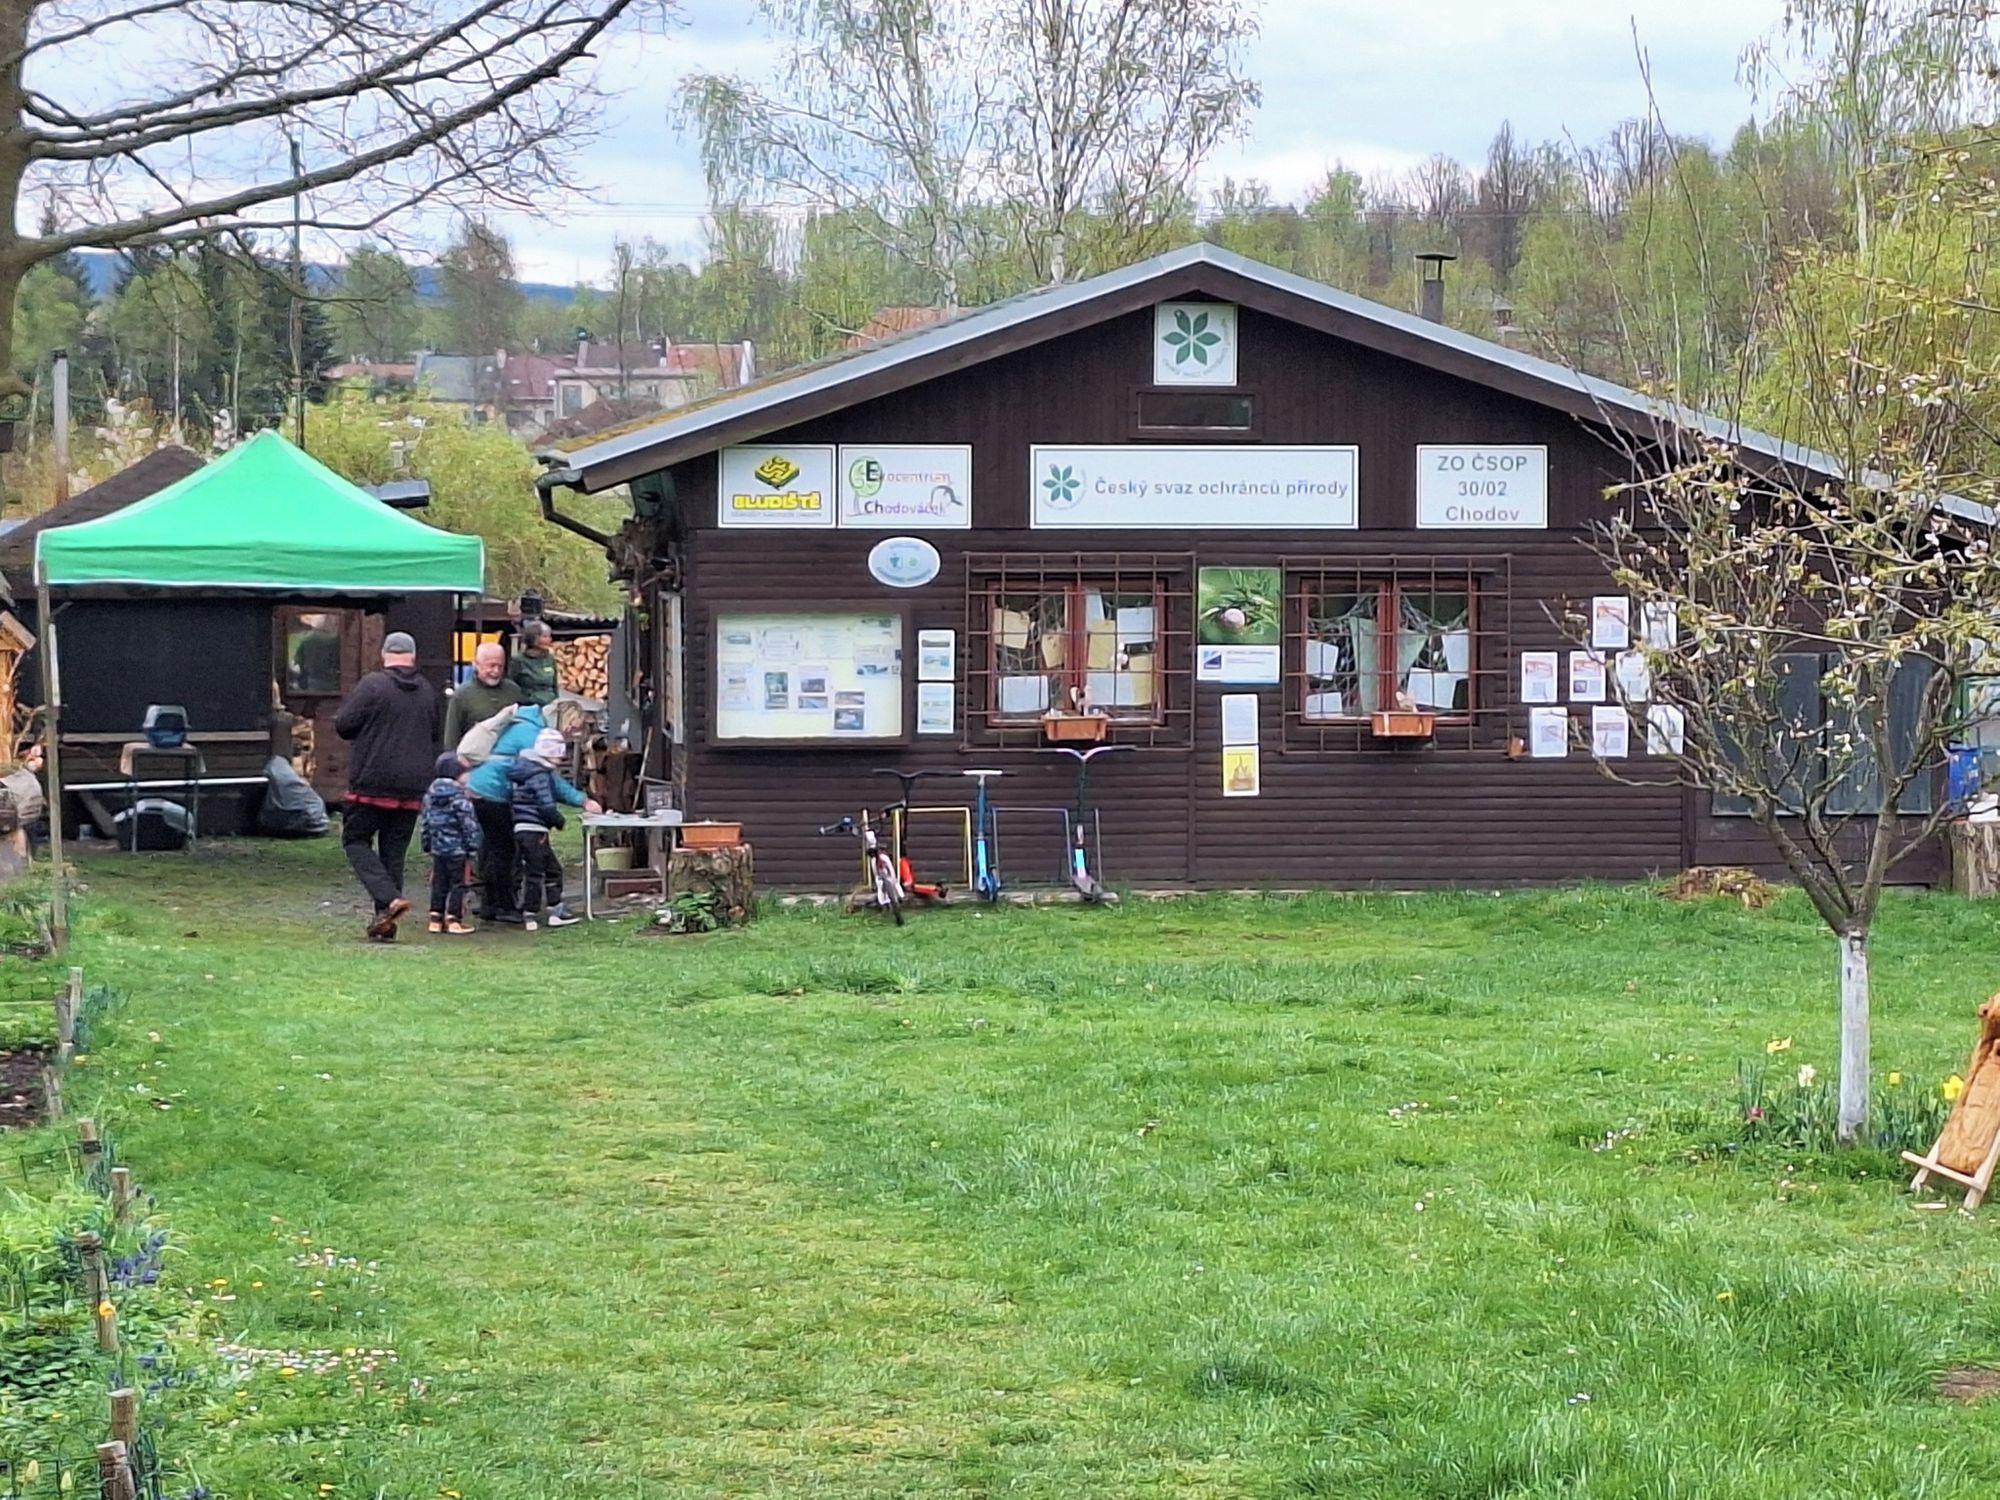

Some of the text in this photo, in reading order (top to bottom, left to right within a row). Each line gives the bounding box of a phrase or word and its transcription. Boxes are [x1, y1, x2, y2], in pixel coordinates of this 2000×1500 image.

[1436, 452, 1528, 472] ZO ČSOP
[1095, 476, 1349, 499] Český svaz ochránců přírody
[1457, 480, 1509, 497] 30/02
[1445, 505, 1521, 522] Chodov
